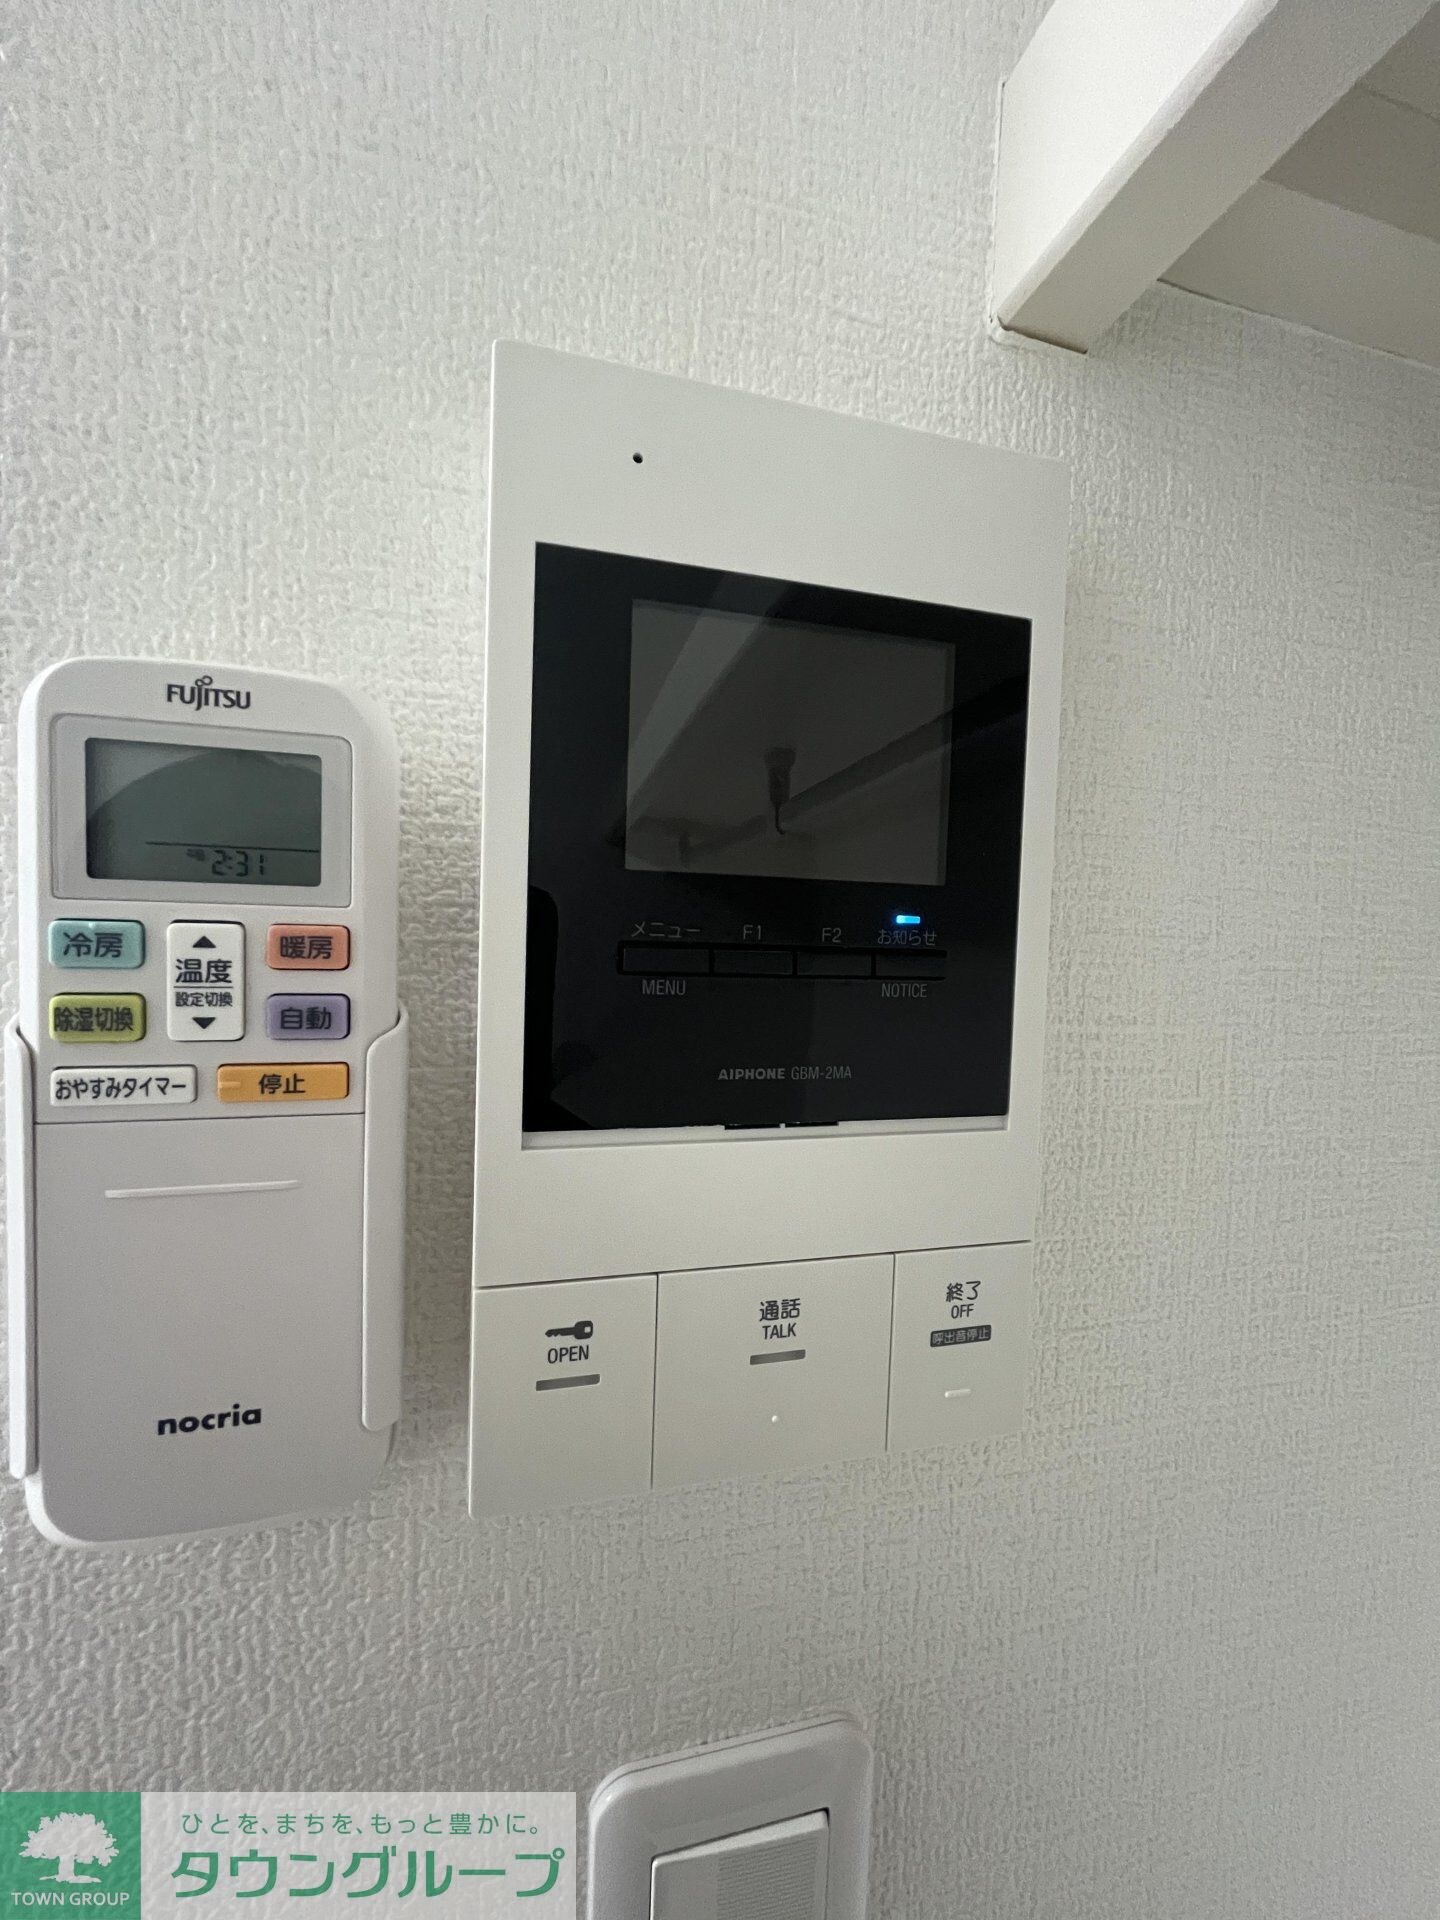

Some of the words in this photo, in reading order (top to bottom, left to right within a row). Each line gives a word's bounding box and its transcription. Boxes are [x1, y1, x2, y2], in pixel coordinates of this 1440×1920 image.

[166, 675, 251, 711] FUJITSU
[631, 921, 701, 938] メニュー
[743, 924, 763, 941] F1
[822, 928, 842, 943] F2
[877, 928, 938, 947] お知らせ
[62, 931, 124, 960] 冷房
[279, 935, 334, 960] 暖房
[175, 958, 233, 984] 温度
[642, 979, 687, 996] MENU
[881, 983, 928, 999] NOTICE
[175, 991, 233, 1008] 設定切換
[54, 1006, 134, 1033] 除湿切換
[279, 1006, 333, 1031] 自動
[718, 1068, 786, 1081] AIPHONE
[790, 1066, 852, 1081] GBM-2MA
[55, 1077, 187, 1101] おやすみタイマー
[257, 1074, 306, 1096] 停止
[945, 1281, 982, 1303] 終了
[758, 1298, 801, 1322] 通話
[950, 1303, 975, 1319] OFF
[762, 1323, 797, 1341] TALK
[931, 1327, 990, 1345] 呼出音停止
[547, 1345, 590, 1364] OPEN
[157, 1403, 262, 1436] nocria
